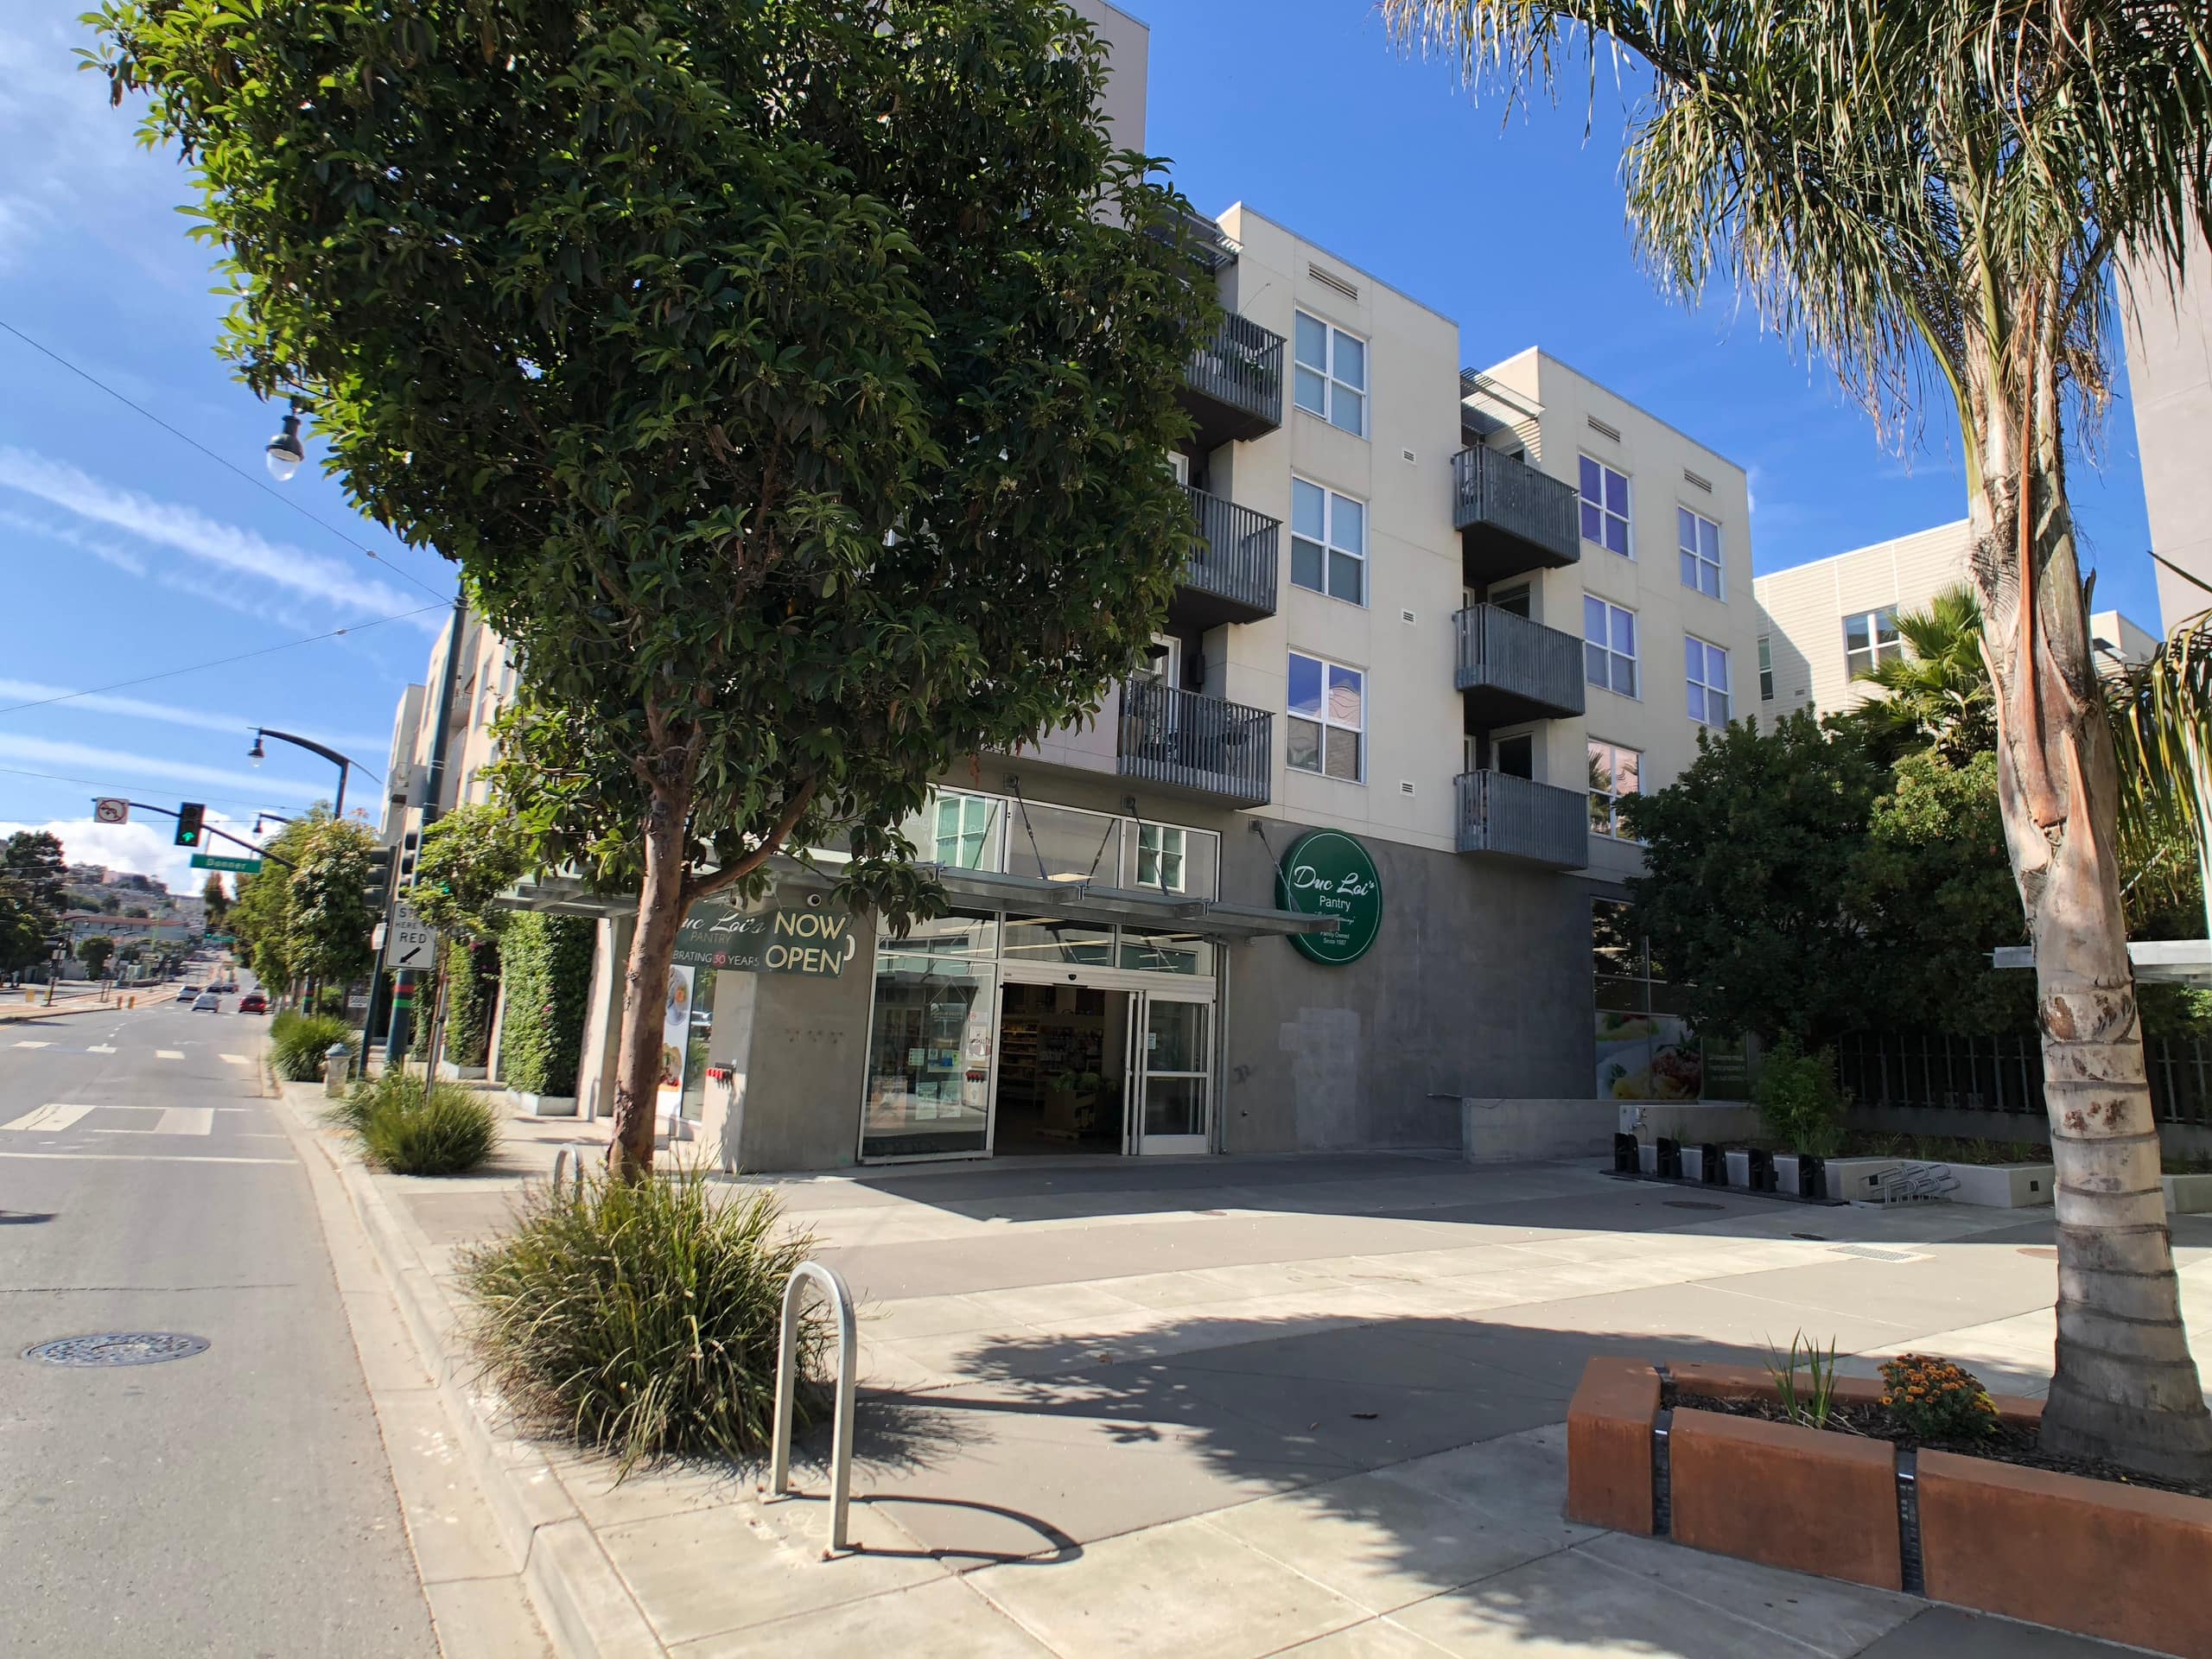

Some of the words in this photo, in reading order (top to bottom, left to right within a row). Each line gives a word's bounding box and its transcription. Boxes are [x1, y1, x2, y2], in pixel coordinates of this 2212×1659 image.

[1294, 865, 1333, 891] Duc
[1337, 872, 1376, 896] Loi's
[1319, 895, 1351, 912] Pantry
[681, 918, 706, 931] uc
[774, 911, 847, 941] NOW
[399, 931, 428, 944] RED
[691, 931, 733, 944] PANTRY
[672, 950, 713, 963] BRATING
[713, 954, 726, 965] 30
[728, 956, 760, 967] YEARS
[765, 944, 842, 976] OPEN
